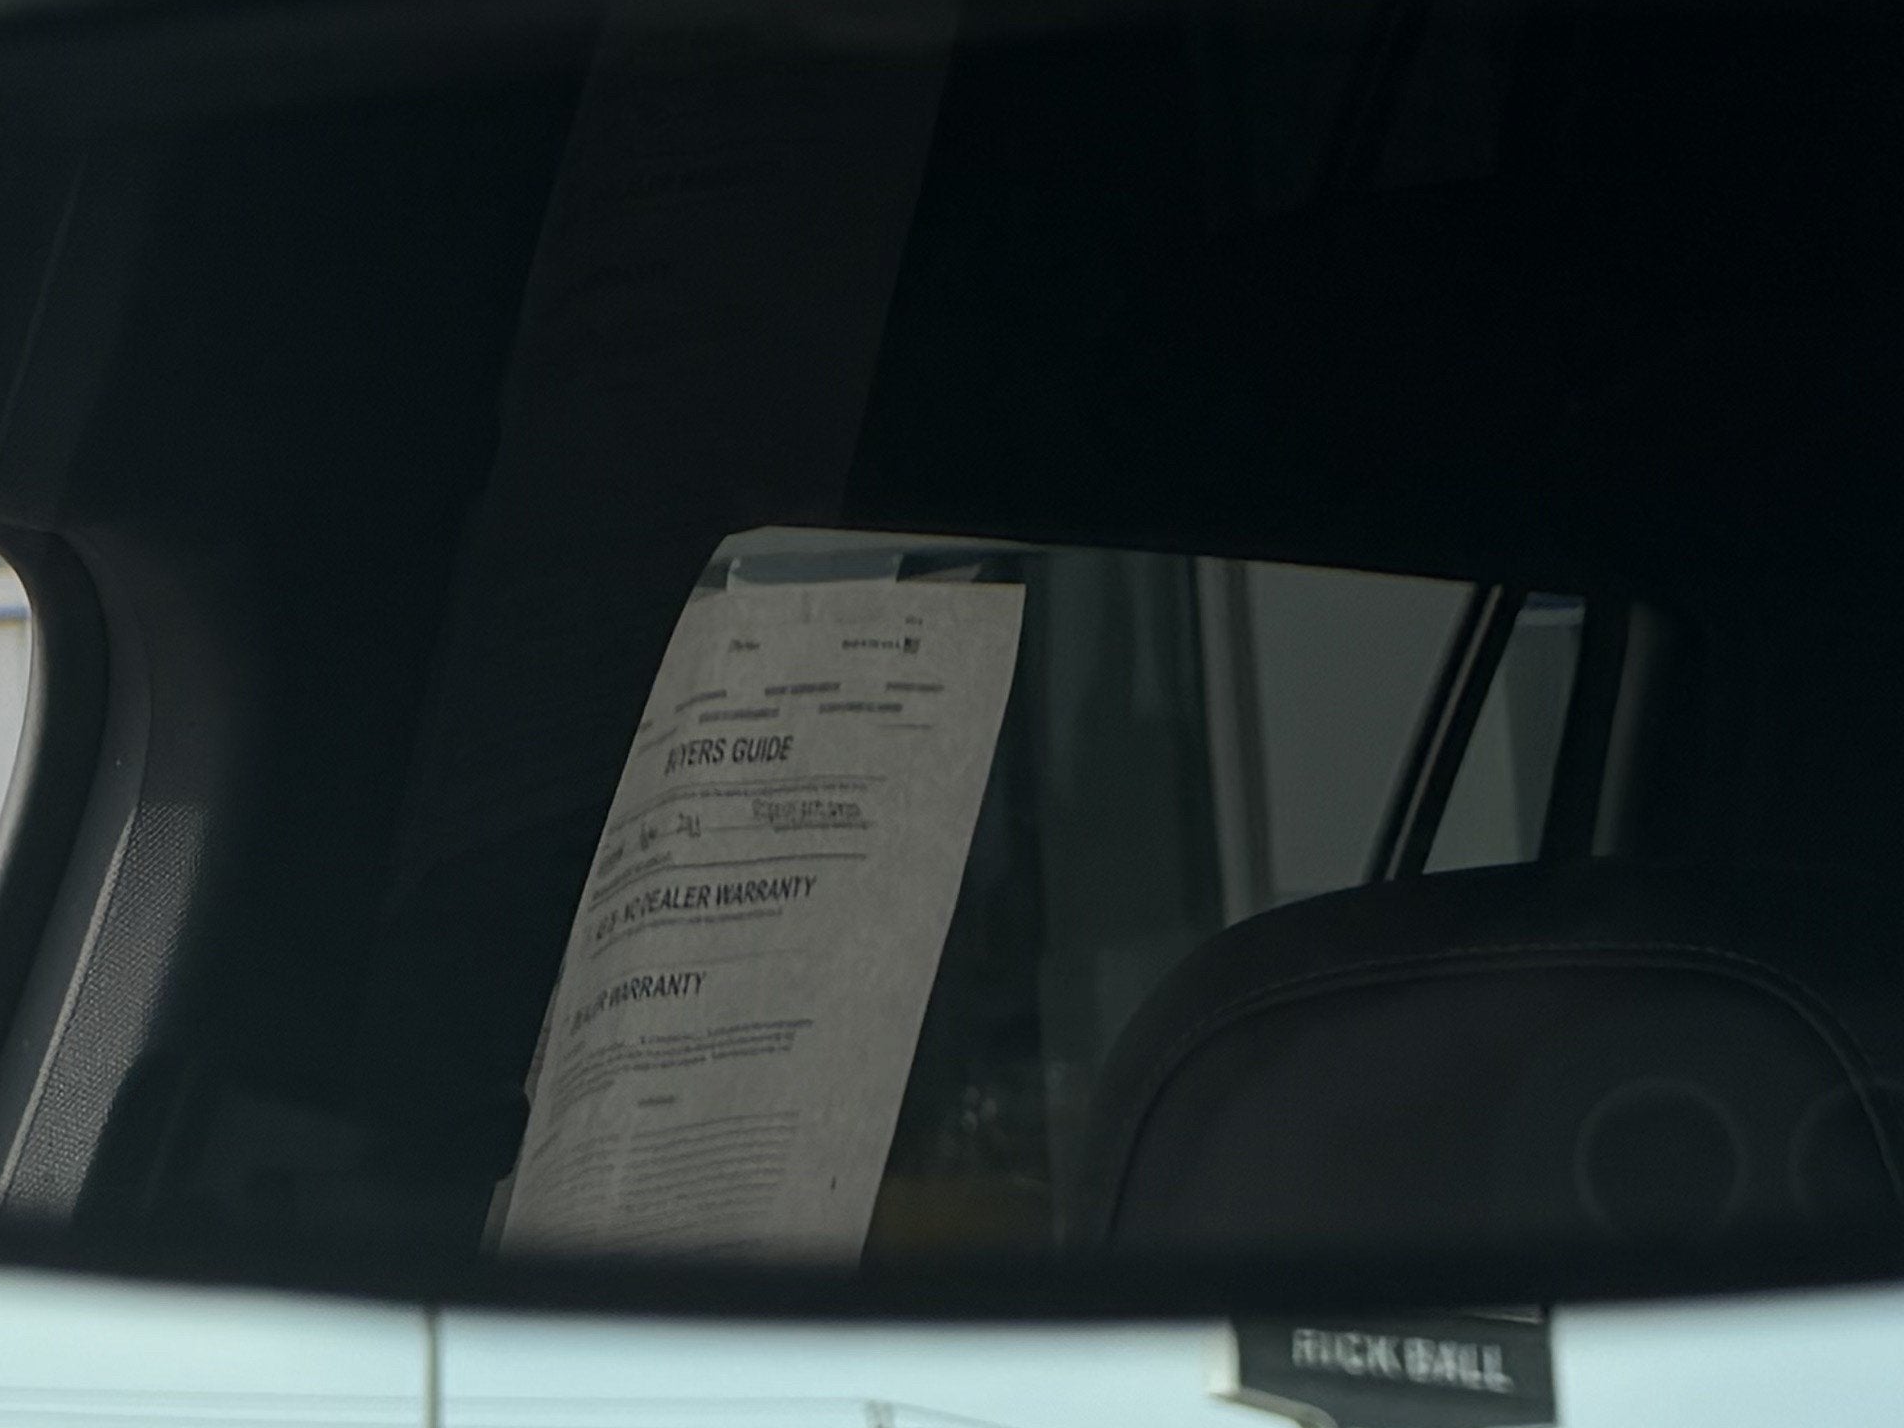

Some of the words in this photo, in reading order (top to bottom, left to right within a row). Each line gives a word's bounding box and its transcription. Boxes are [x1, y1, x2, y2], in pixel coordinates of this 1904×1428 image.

[731, 734, 794, 764] GUIDE
[715, 874, 818, 906] WARRANTY
[608, 971, 708, 1008] WARRANTY
[1292, 1327, 1402, 1378] RICK
[1402, 1336, 1516, 1394] BALL
